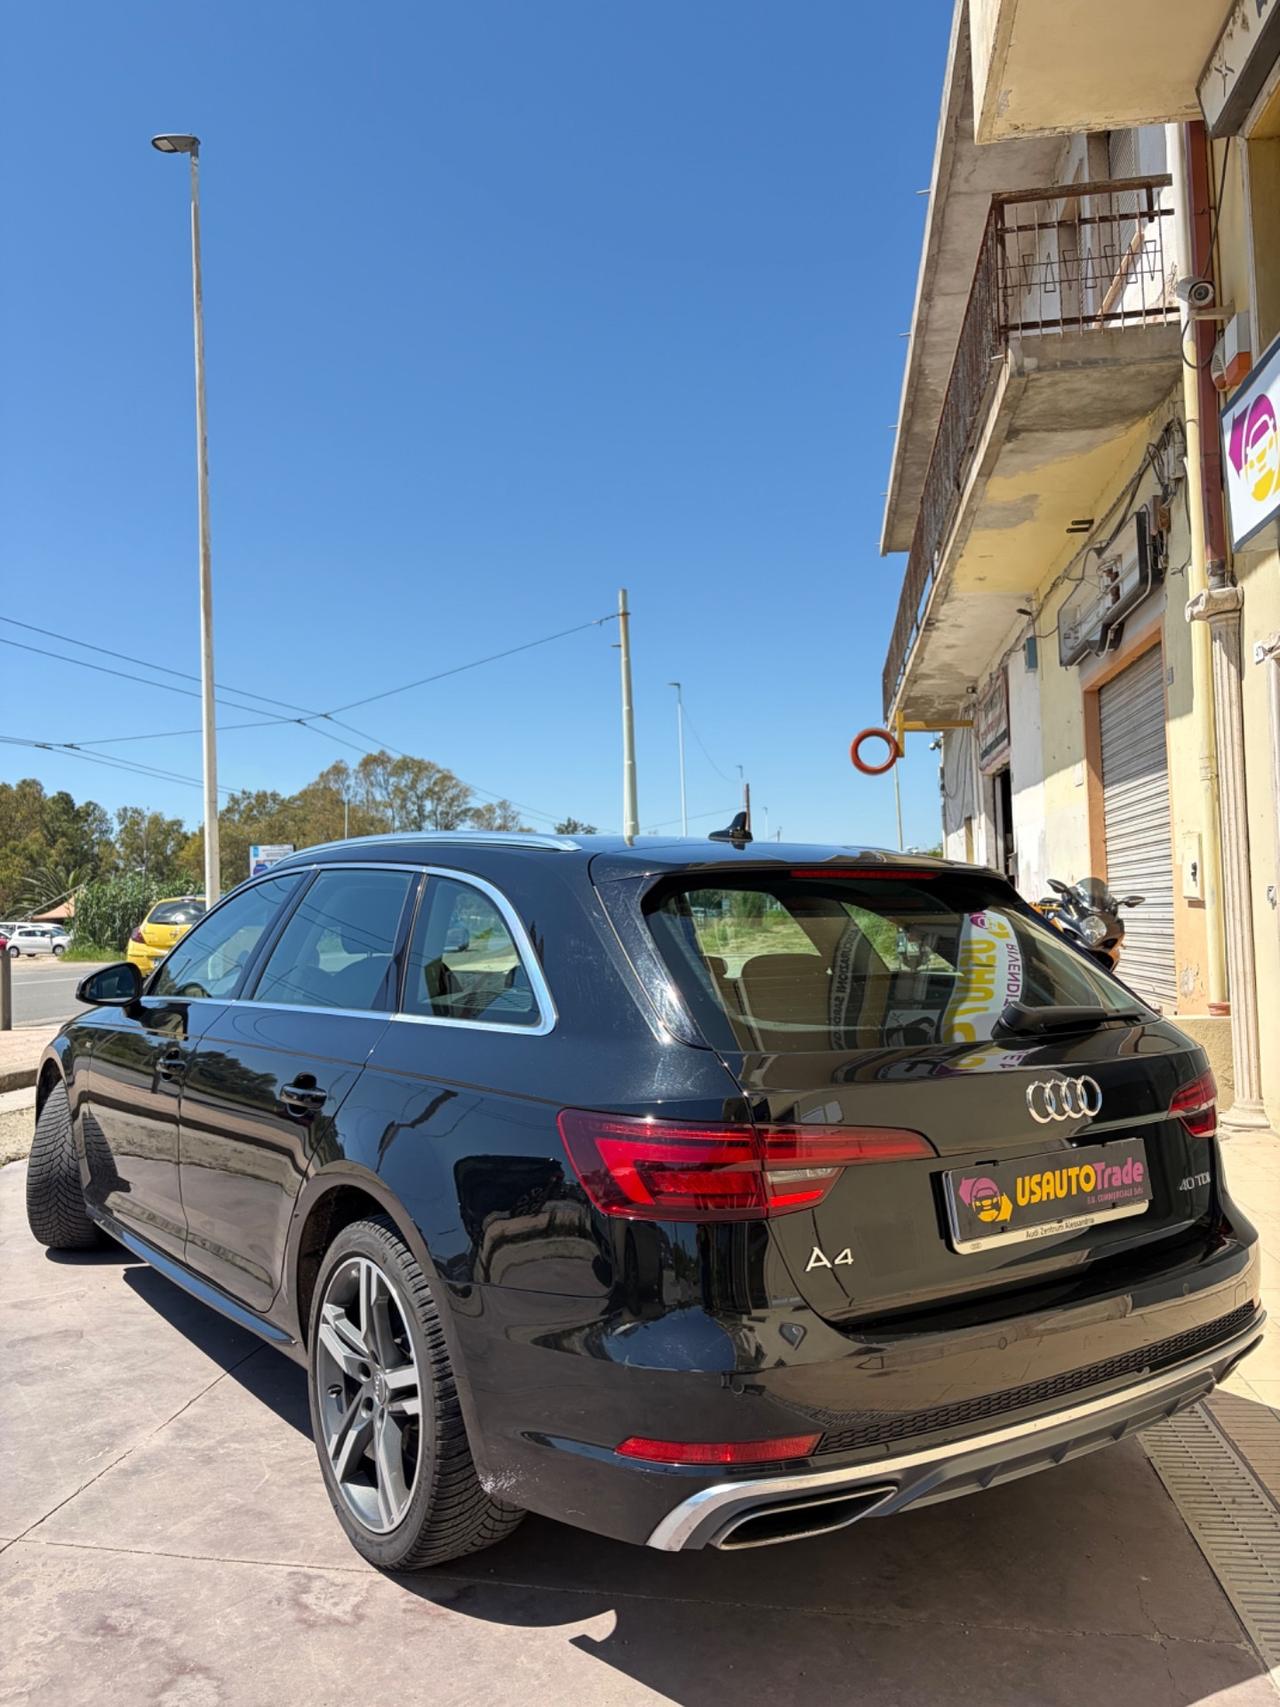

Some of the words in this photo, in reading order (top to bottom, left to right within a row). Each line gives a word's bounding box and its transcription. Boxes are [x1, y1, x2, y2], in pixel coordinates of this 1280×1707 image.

[1179, 1176, 1195, 1191] 40
[1195, 1171, 1211, 1186] TDI
[1026, 1229, 1039, 1238] Audi
[805, 1246, 854, 1272] A4
